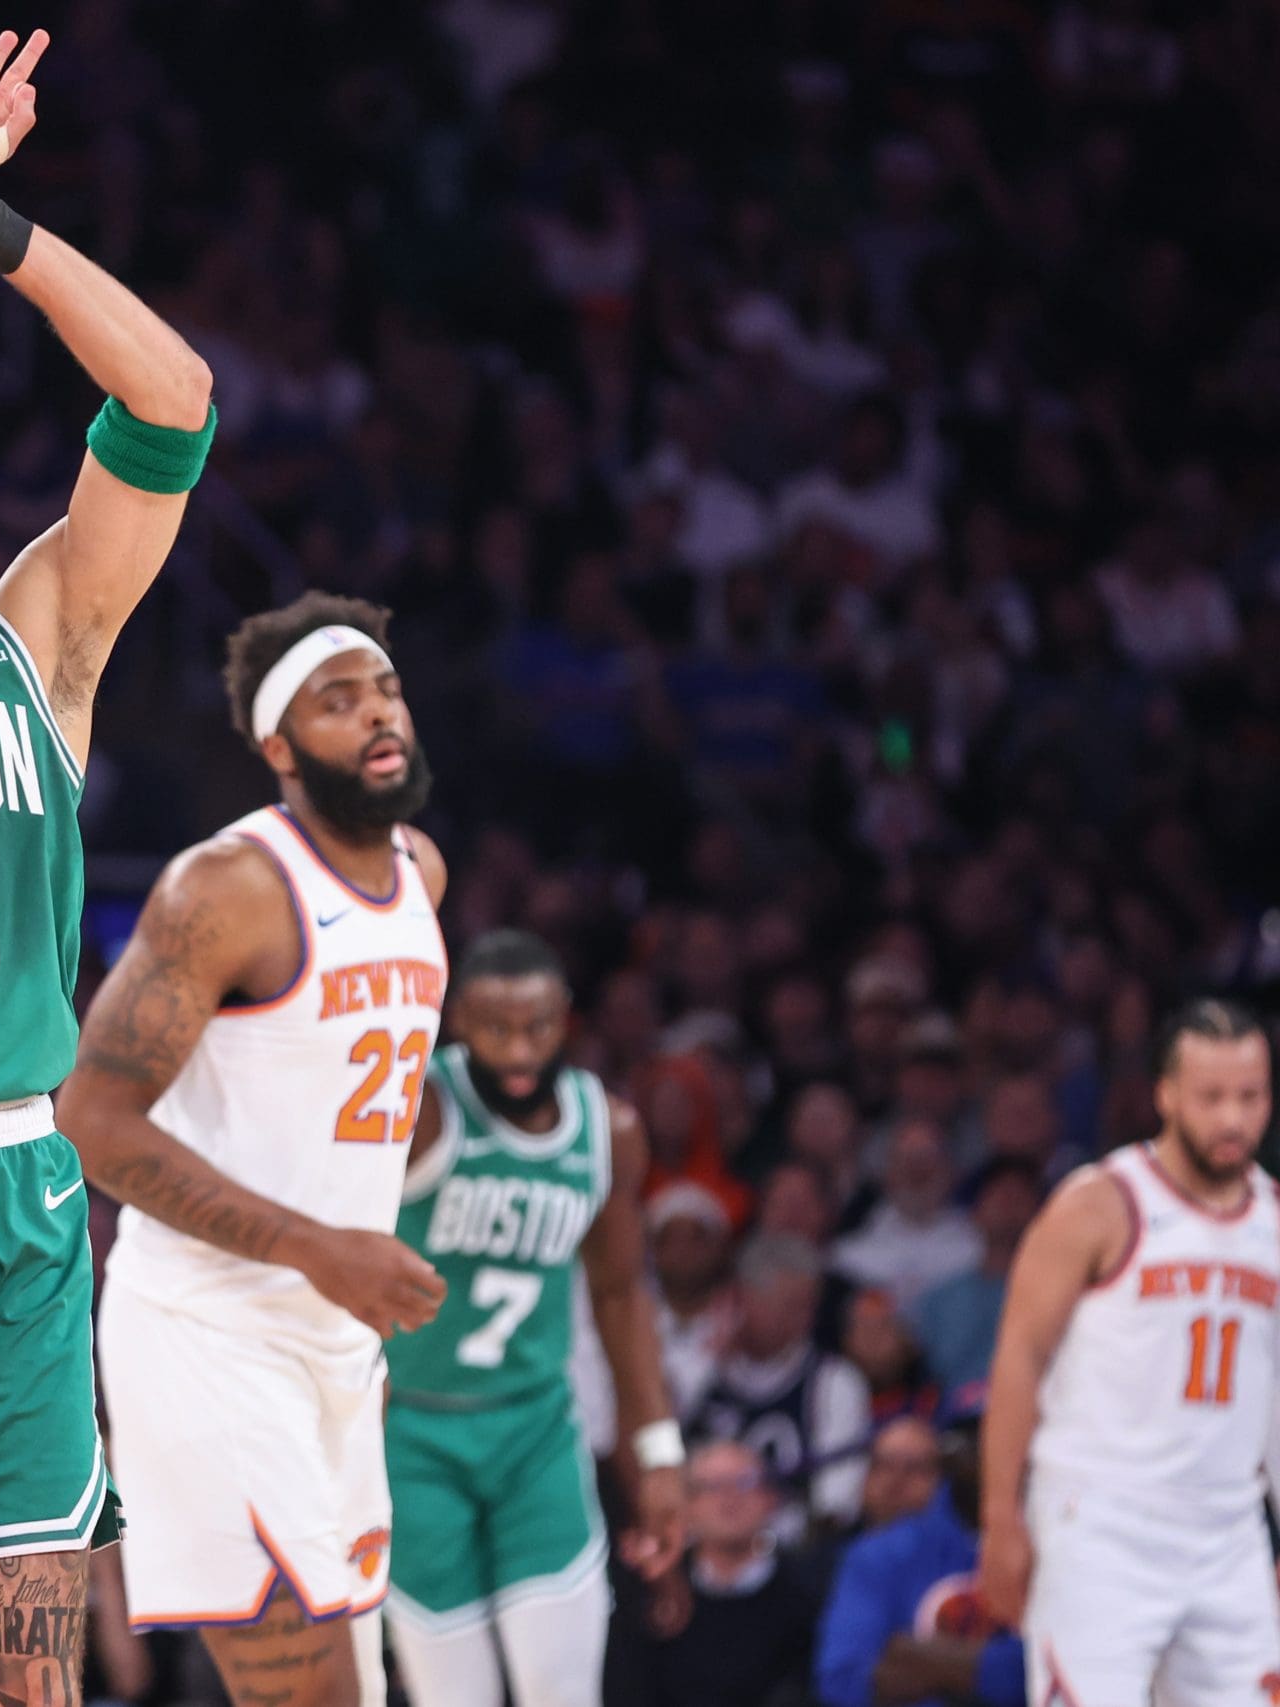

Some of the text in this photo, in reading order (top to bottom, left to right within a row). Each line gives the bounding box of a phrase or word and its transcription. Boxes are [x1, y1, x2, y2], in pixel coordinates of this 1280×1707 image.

[317, 960, 394, 1022] NEW
[334, 1027, 430, 1143] 23
[455, 1265, 544, 1370] 7
[1184, 1314, 1242, 1406] 11
